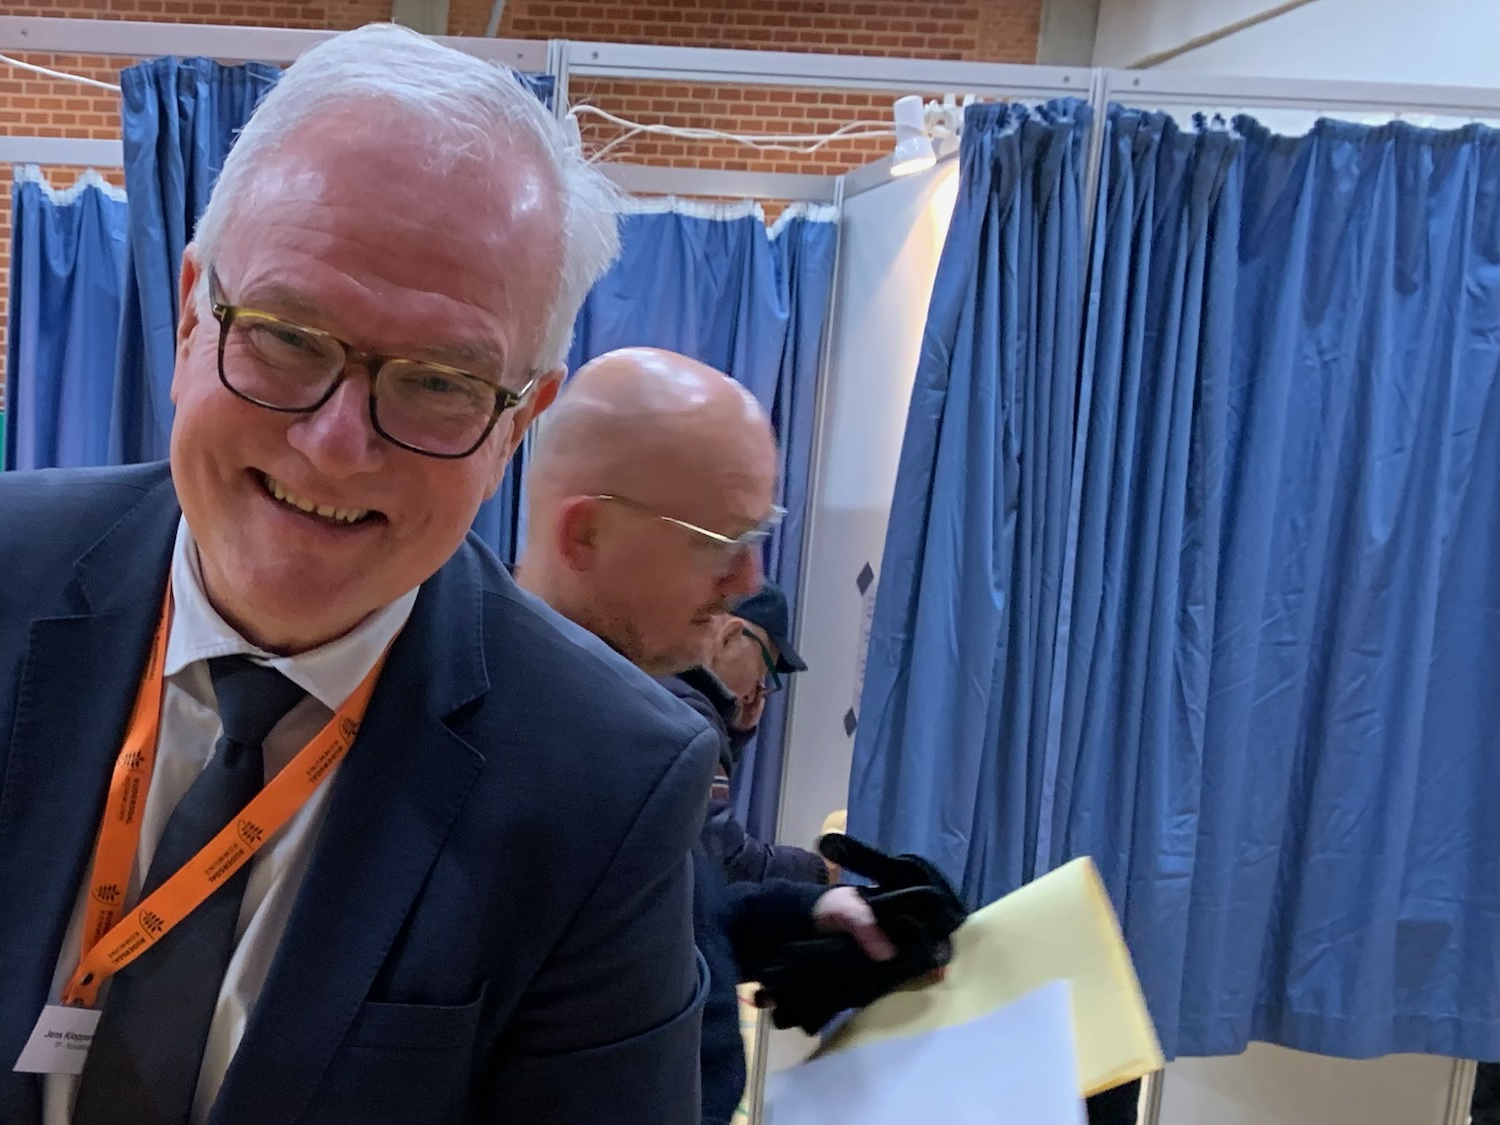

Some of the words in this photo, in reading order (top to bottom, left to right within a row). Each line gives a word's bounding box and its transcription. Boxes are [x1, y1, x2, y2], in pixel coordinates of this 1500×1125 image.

[203, 842, 239, 876] KOMMUNE
[207, 849, 245, 883] RUDERSDAL
[111, 937, 146, 965] RUDERSDAL
